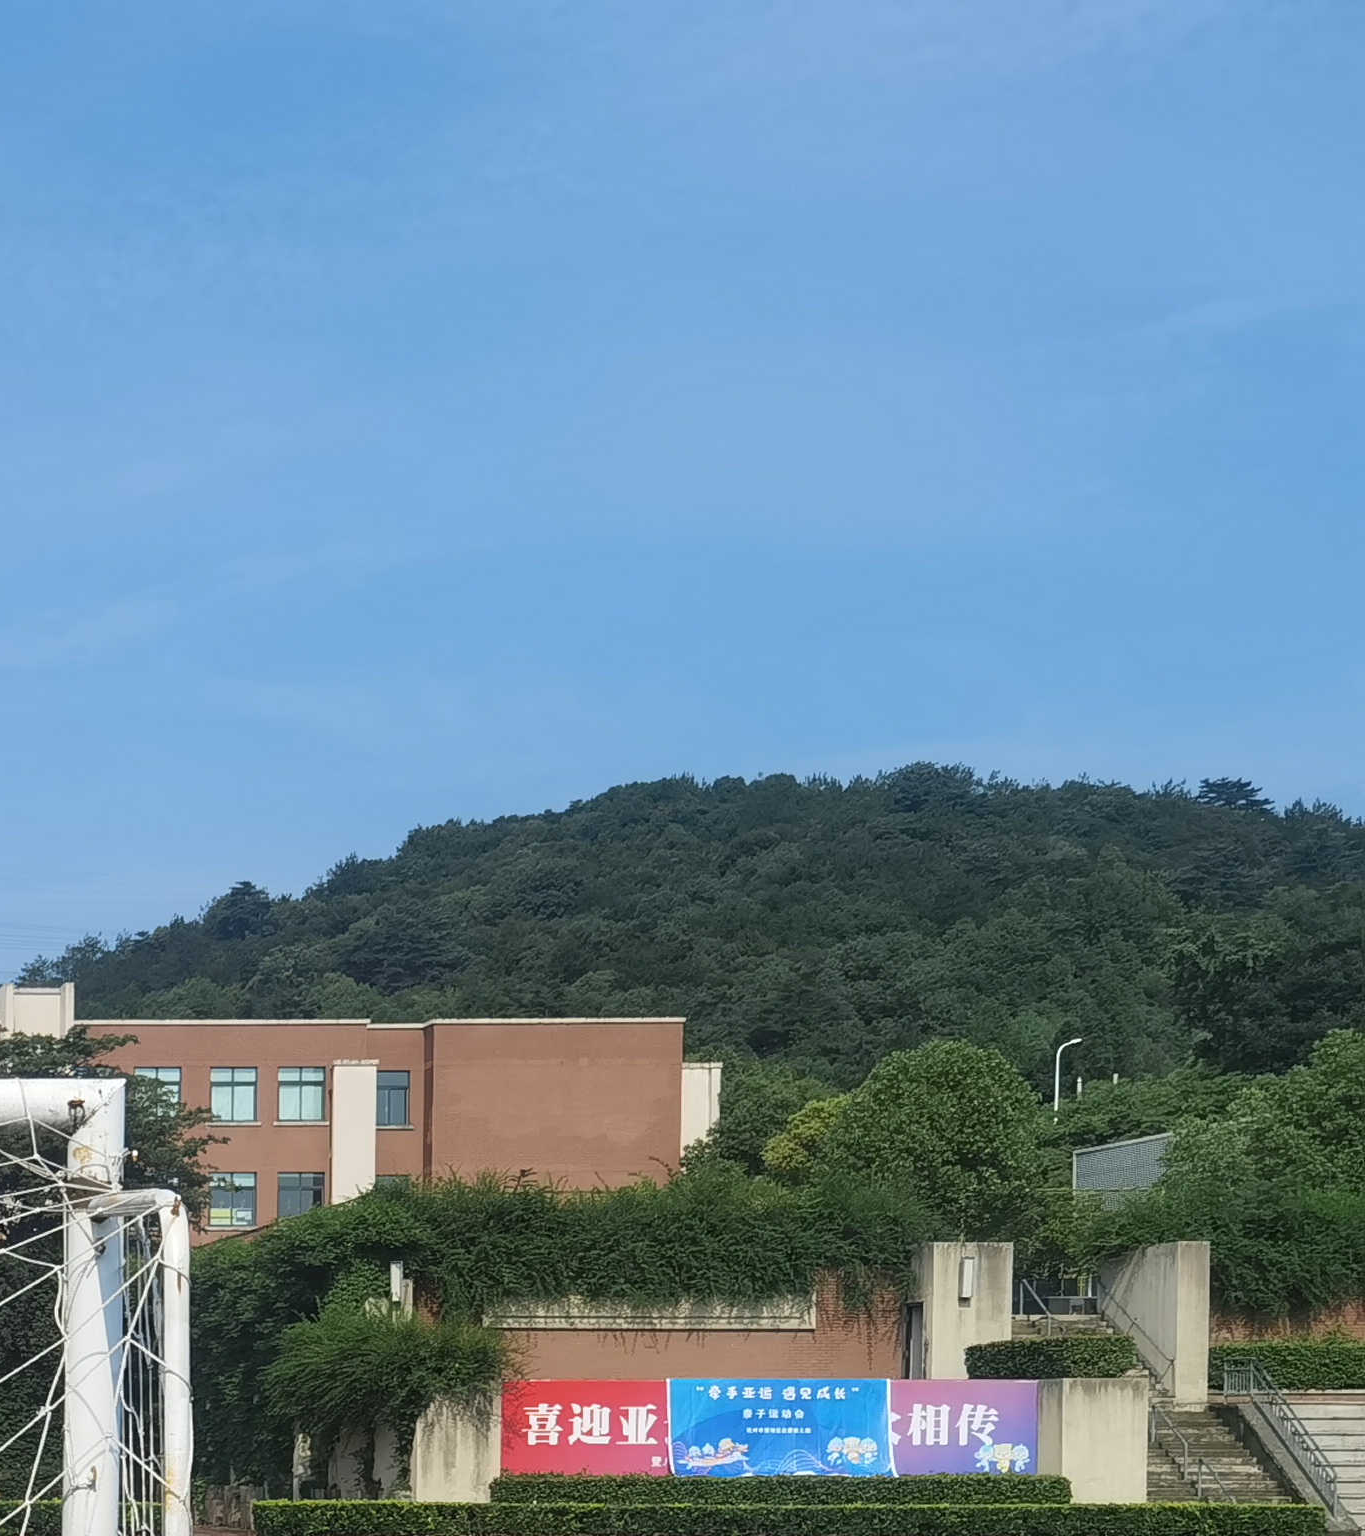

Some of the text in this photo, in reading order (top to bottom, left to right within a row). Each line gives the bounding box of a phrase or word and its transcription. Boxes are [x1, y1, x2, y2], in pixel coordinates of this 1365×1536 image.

[521, 1403, 999, 1446] 喜迎亚 相传
[743, 1408, 805, 1419] 亲子运动会
